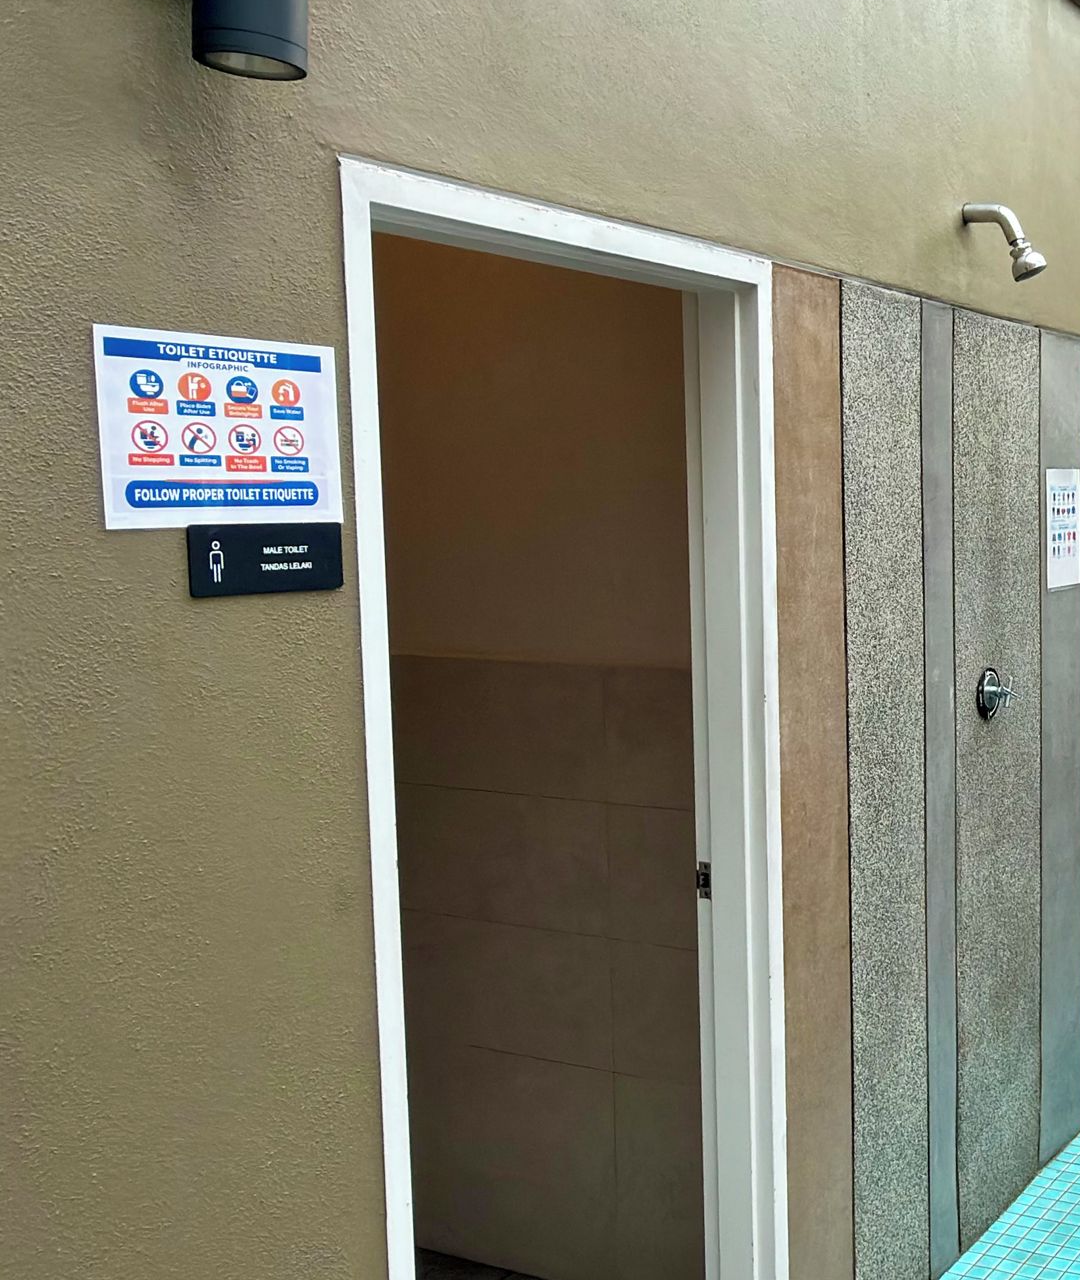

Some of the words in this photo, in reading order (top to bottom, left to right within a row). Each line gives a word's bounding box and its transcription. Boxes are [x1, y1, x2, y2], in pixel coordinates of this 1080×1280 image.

[157, 344, 205, 357] TOILET
[209, 348, 277, 364] ETIQUETTE
[187, 361, 248, 372] INFOGRAPHIC
[135, 489, 180, 501] FOLLOW
[183, 489, 224, 501] PROPER
[226, 488, 262, 500] TOILET
[263, 488, 314, 501] ETIQUETTE
[284, 545, 308, 554] TOILET
[260, 562, 288, 571] TANDAS
[289, 562, 313, 570] LELAKI
